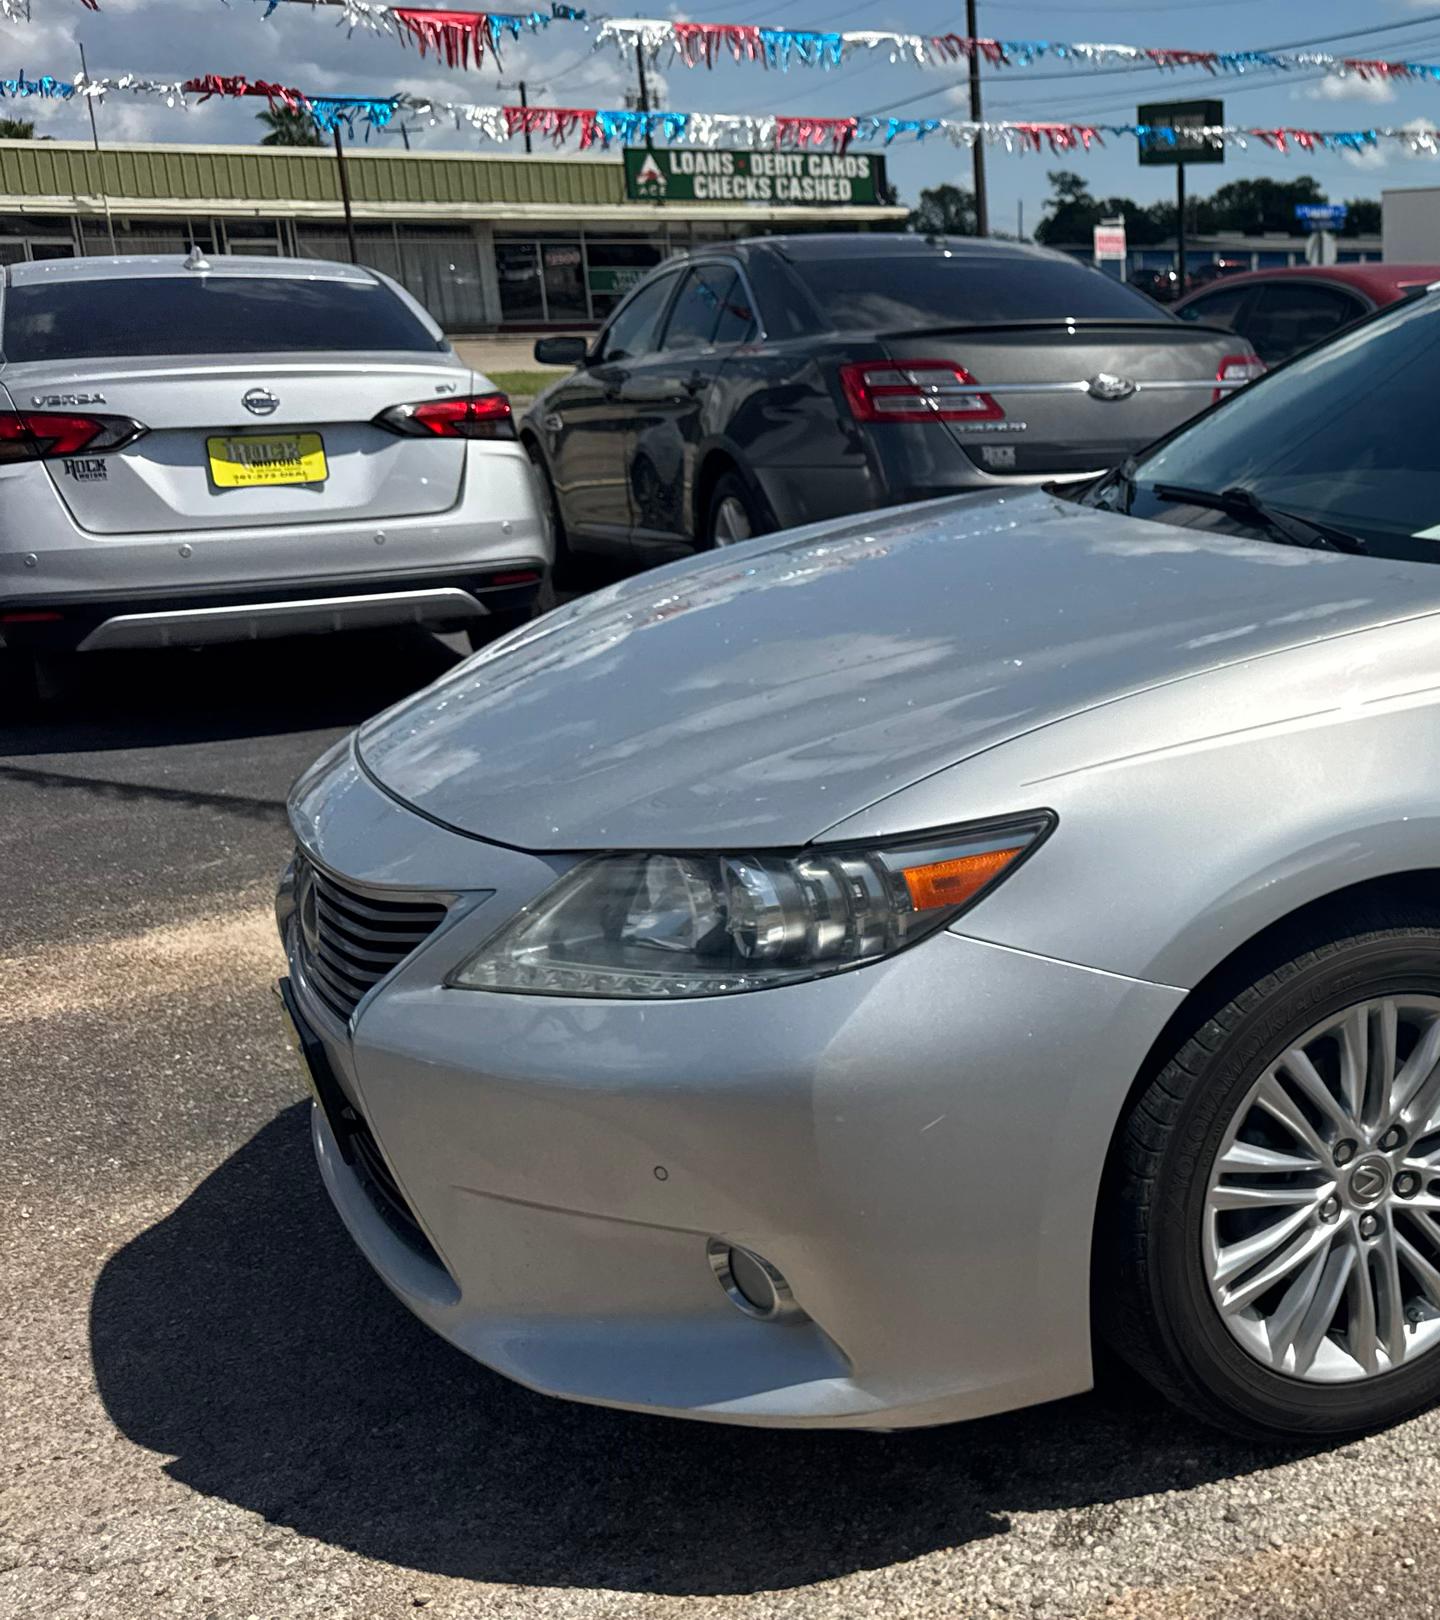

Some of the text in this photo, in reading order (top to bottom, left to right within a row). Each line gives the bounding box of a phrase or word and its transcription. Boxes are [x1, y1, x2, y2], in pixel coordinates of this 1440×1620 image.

[669, 151, 870, 178] LOANS DEBIT CARDS
[639, 185, 667, 196] ACE
[692, 176, 853, 201] CHECKS CASHED
[434, 383, 456, 394] SV
[31, 393, 107, 408] VERSA
[61, 459, 107, 481] ROCK
[250, 457, 303, 469] MOTORS
